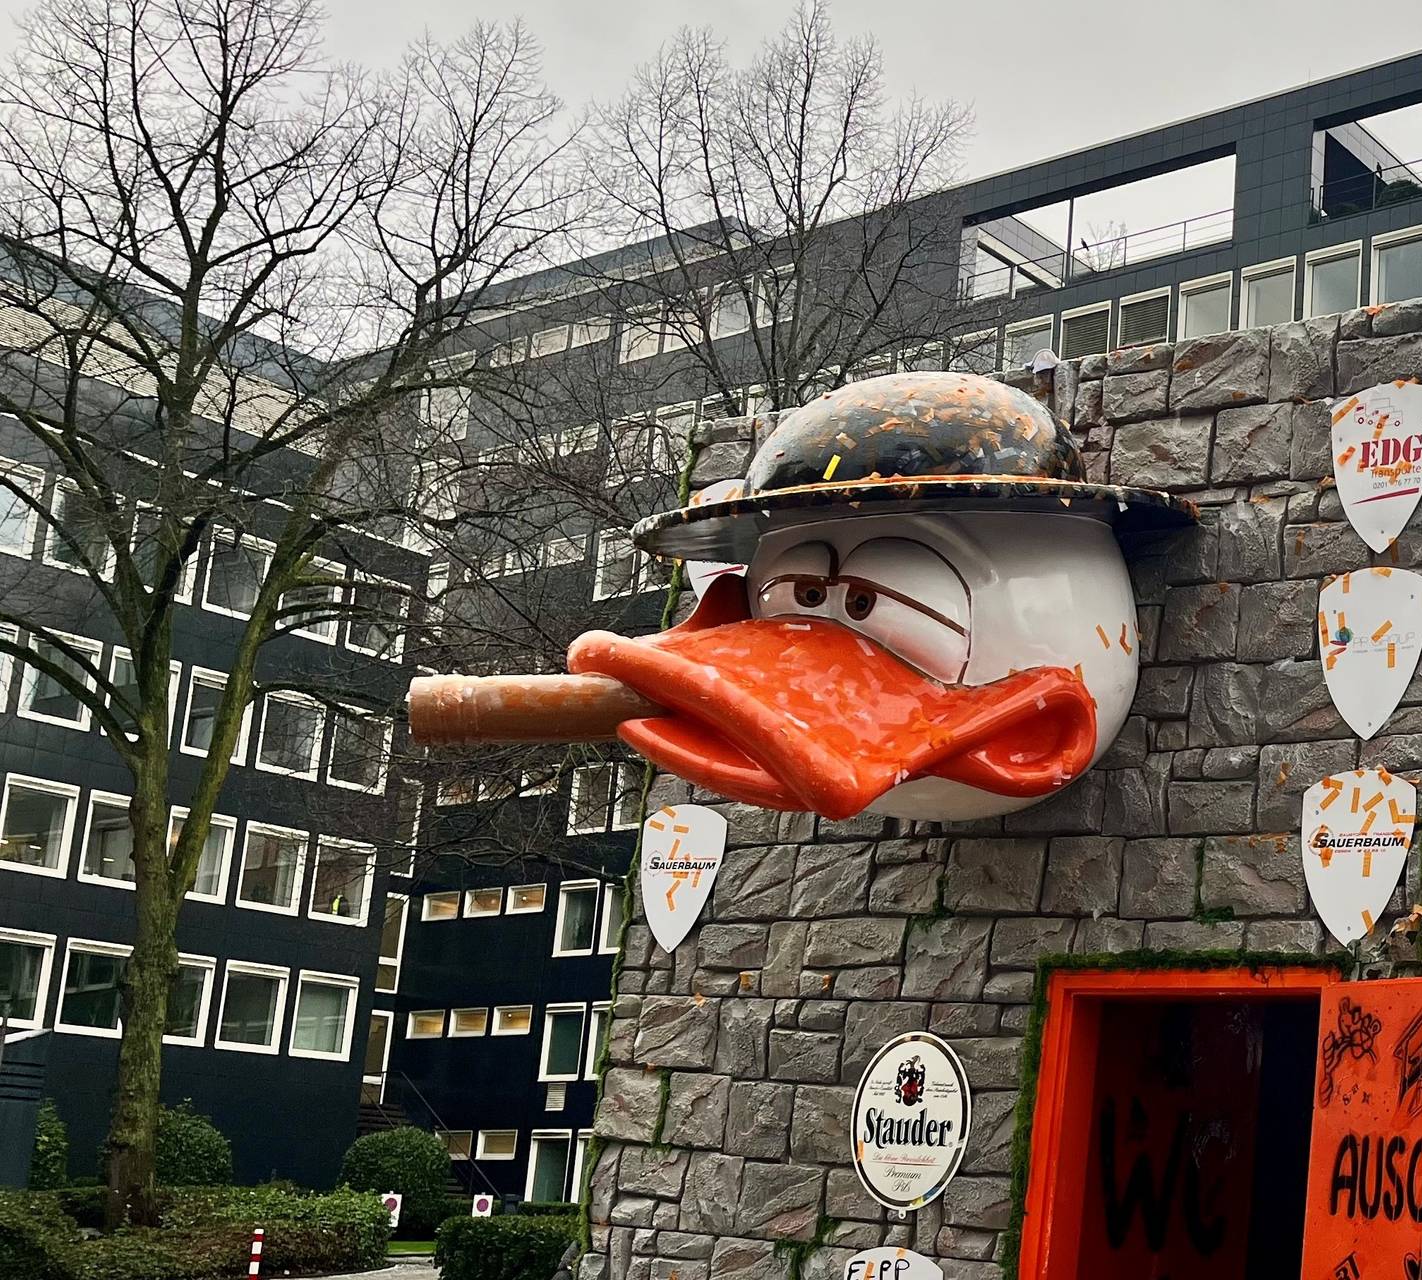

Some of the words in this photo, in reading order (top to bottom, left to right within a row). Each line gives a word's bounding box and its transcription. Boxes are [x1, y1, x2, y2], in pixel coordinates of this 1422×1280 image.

[1360, 434, 1422, 469] EDG
[1312, 833, 1406, 849] SAUERBAUM
[649, 856, 717, 870] SAUERBAUM
[864, 1107, 953, 1149] Stauder
[884, 1166, 922, 1179] Premium
[891, 1180, 912, 1193] Pils
